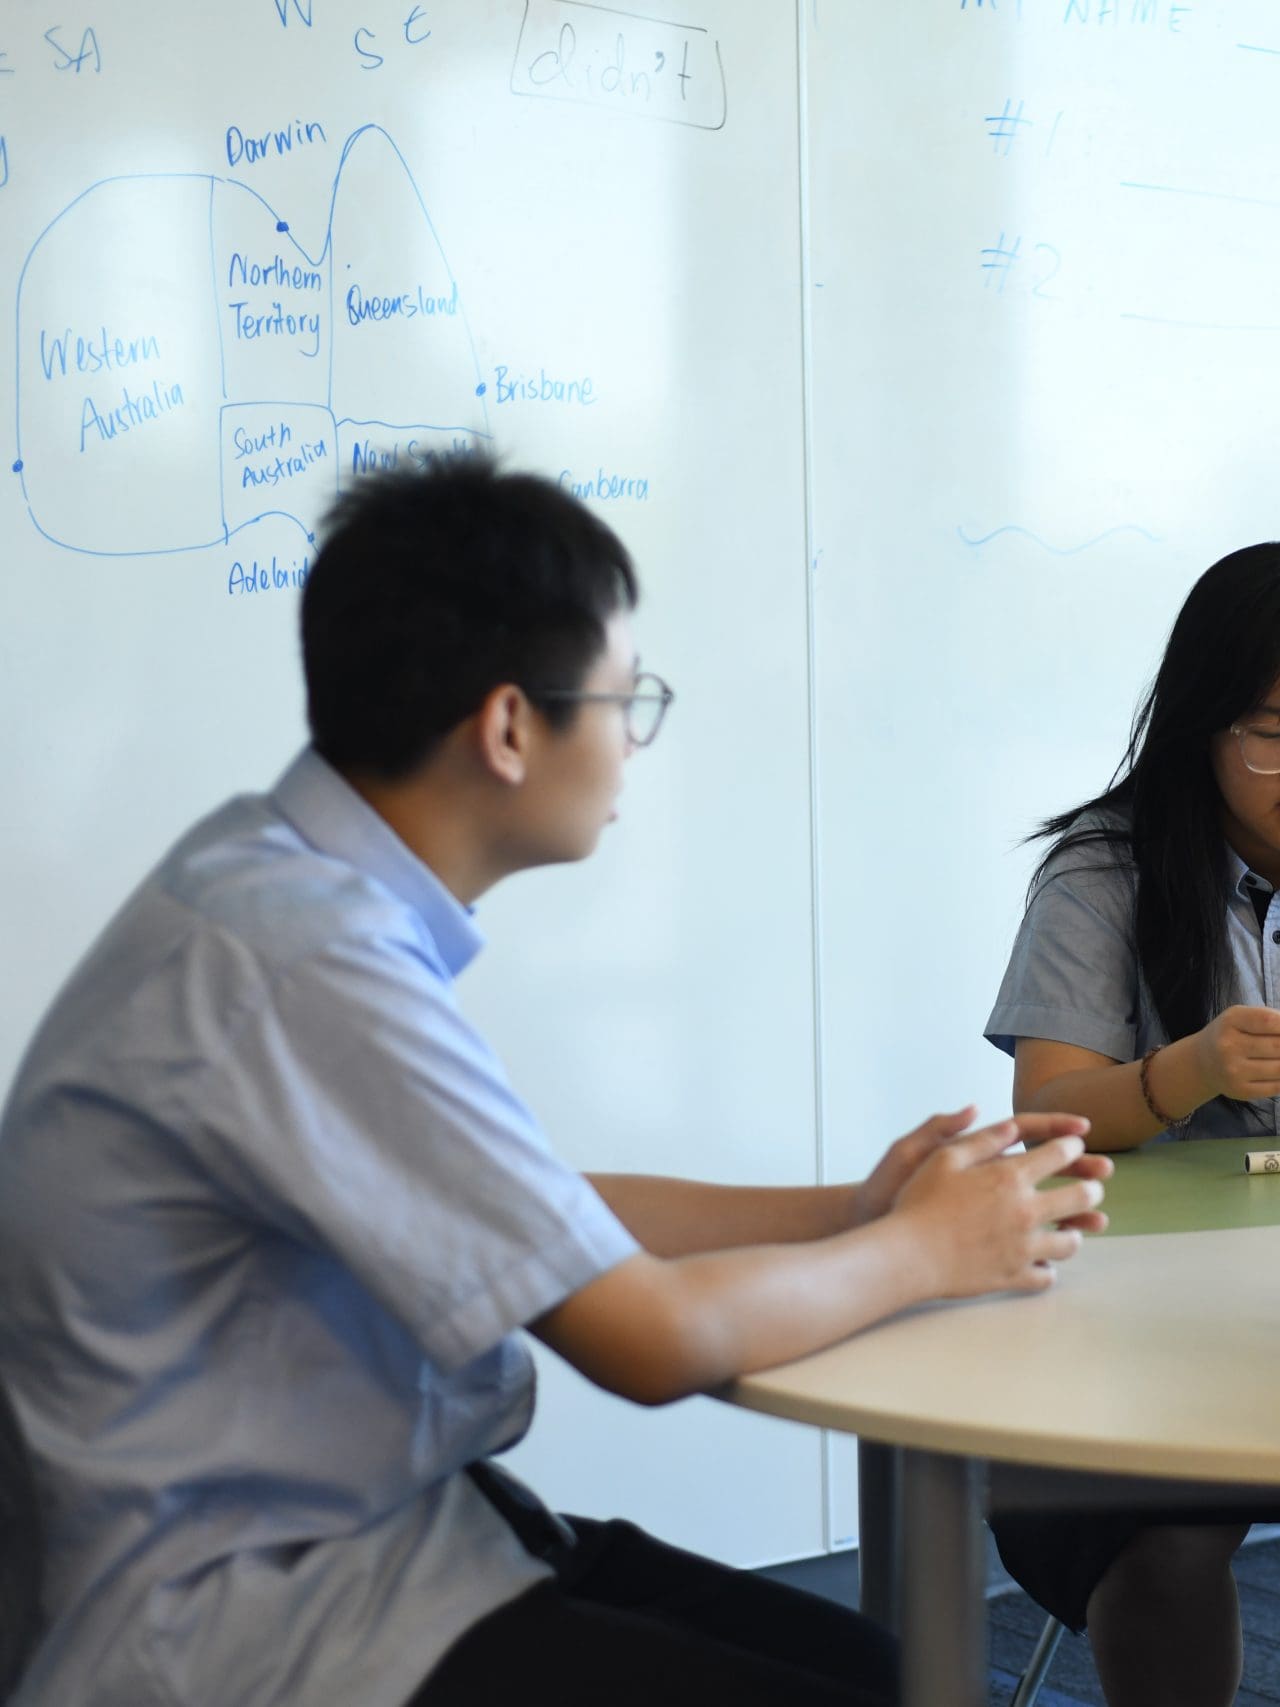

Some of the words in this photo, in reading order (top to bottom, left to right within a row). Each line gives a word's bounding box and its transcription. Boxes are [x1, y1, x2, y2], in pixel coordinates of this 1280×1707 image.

[44, 25, 101, 73] SA
[354, 27, 384, 70] S
[527, 22, 692, 102] didn't
[226, 119, 328, 167] Darwin
[229, 252, 323, 292] Northern
[346, 281, 459, 326] Queensland
[41, 326, 161, 380] Western
[228, 301, 321, 358] Territory
[494, 366, 598, 404] Brisbane
[79, 380, 185, 452] Australia
[234, 422, 292, 460] South
[242, 439, 328, 488] Australia
[229, 556, 308, 595] Adelaid
